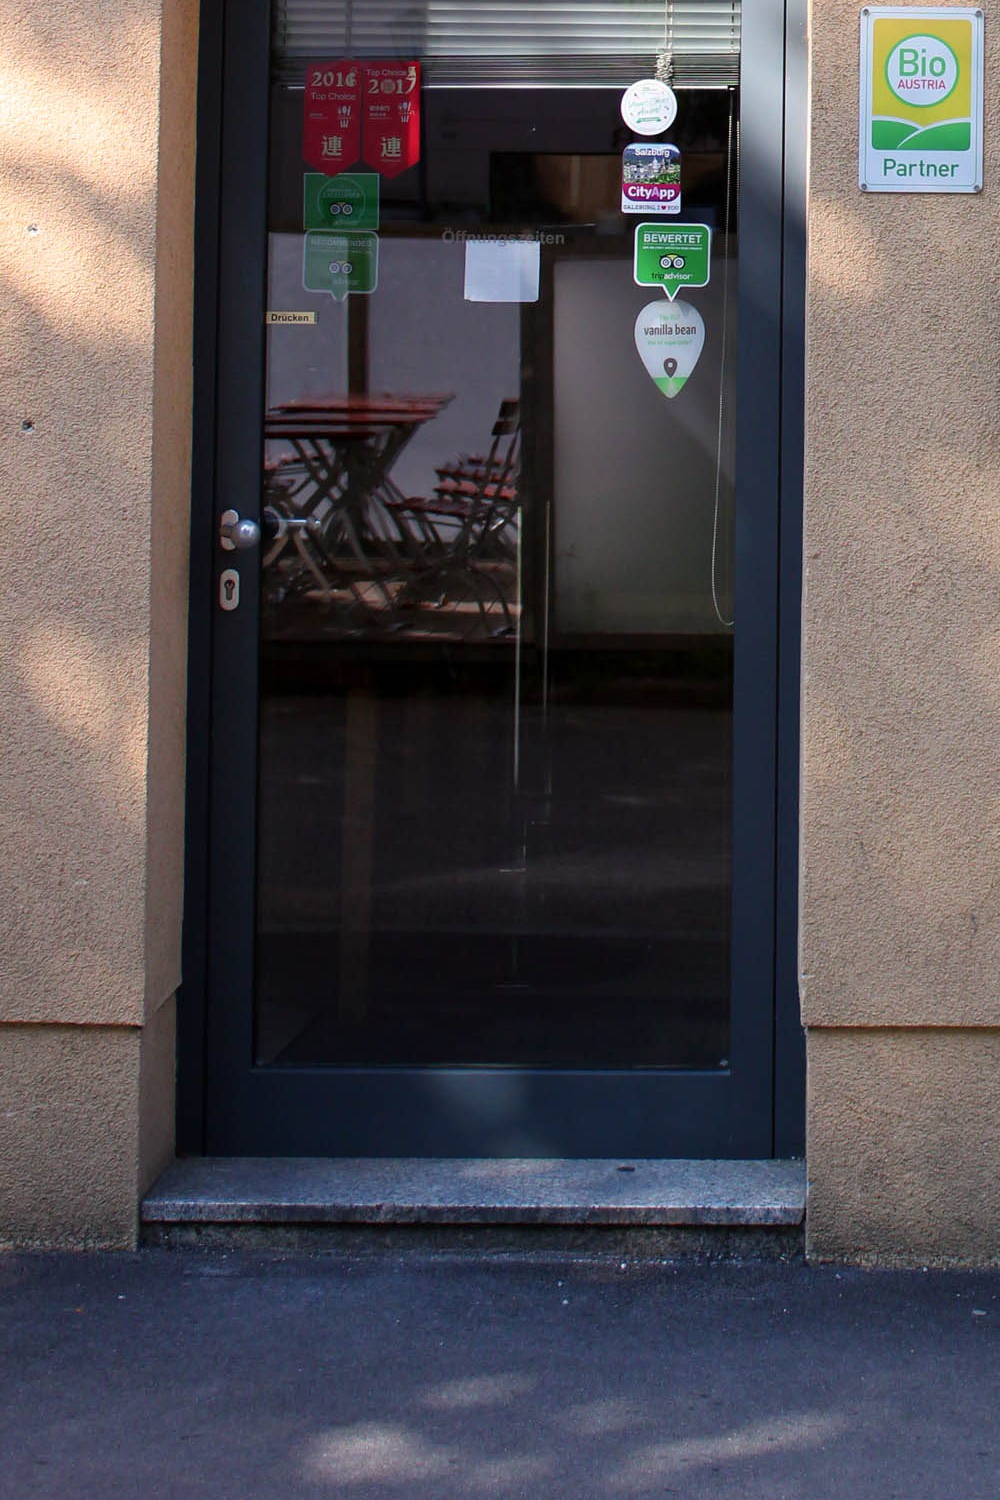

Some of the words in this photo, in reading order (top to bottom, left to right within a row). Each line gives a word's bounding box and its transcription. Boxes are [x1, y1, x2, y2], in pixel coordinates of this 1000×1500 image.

[899, 48, 946, 77] Bio
[311, 71, 357, 88] 2016
[898, 79, 946, 90] AUSTRIA
[634, 148, 670, 158] Salzburg
[883, 158, 960, 178] Partner
[628, 186, 676, 200] CityApp
[442, 228, 565, 247] Öffnungszeiten
[643, 233, 703, 244] BEWERTET
[652, 271, 692, 281] tripadvisor
[643, 324, 673, 336] vanilla
[675, 324, 697, 336] bean
